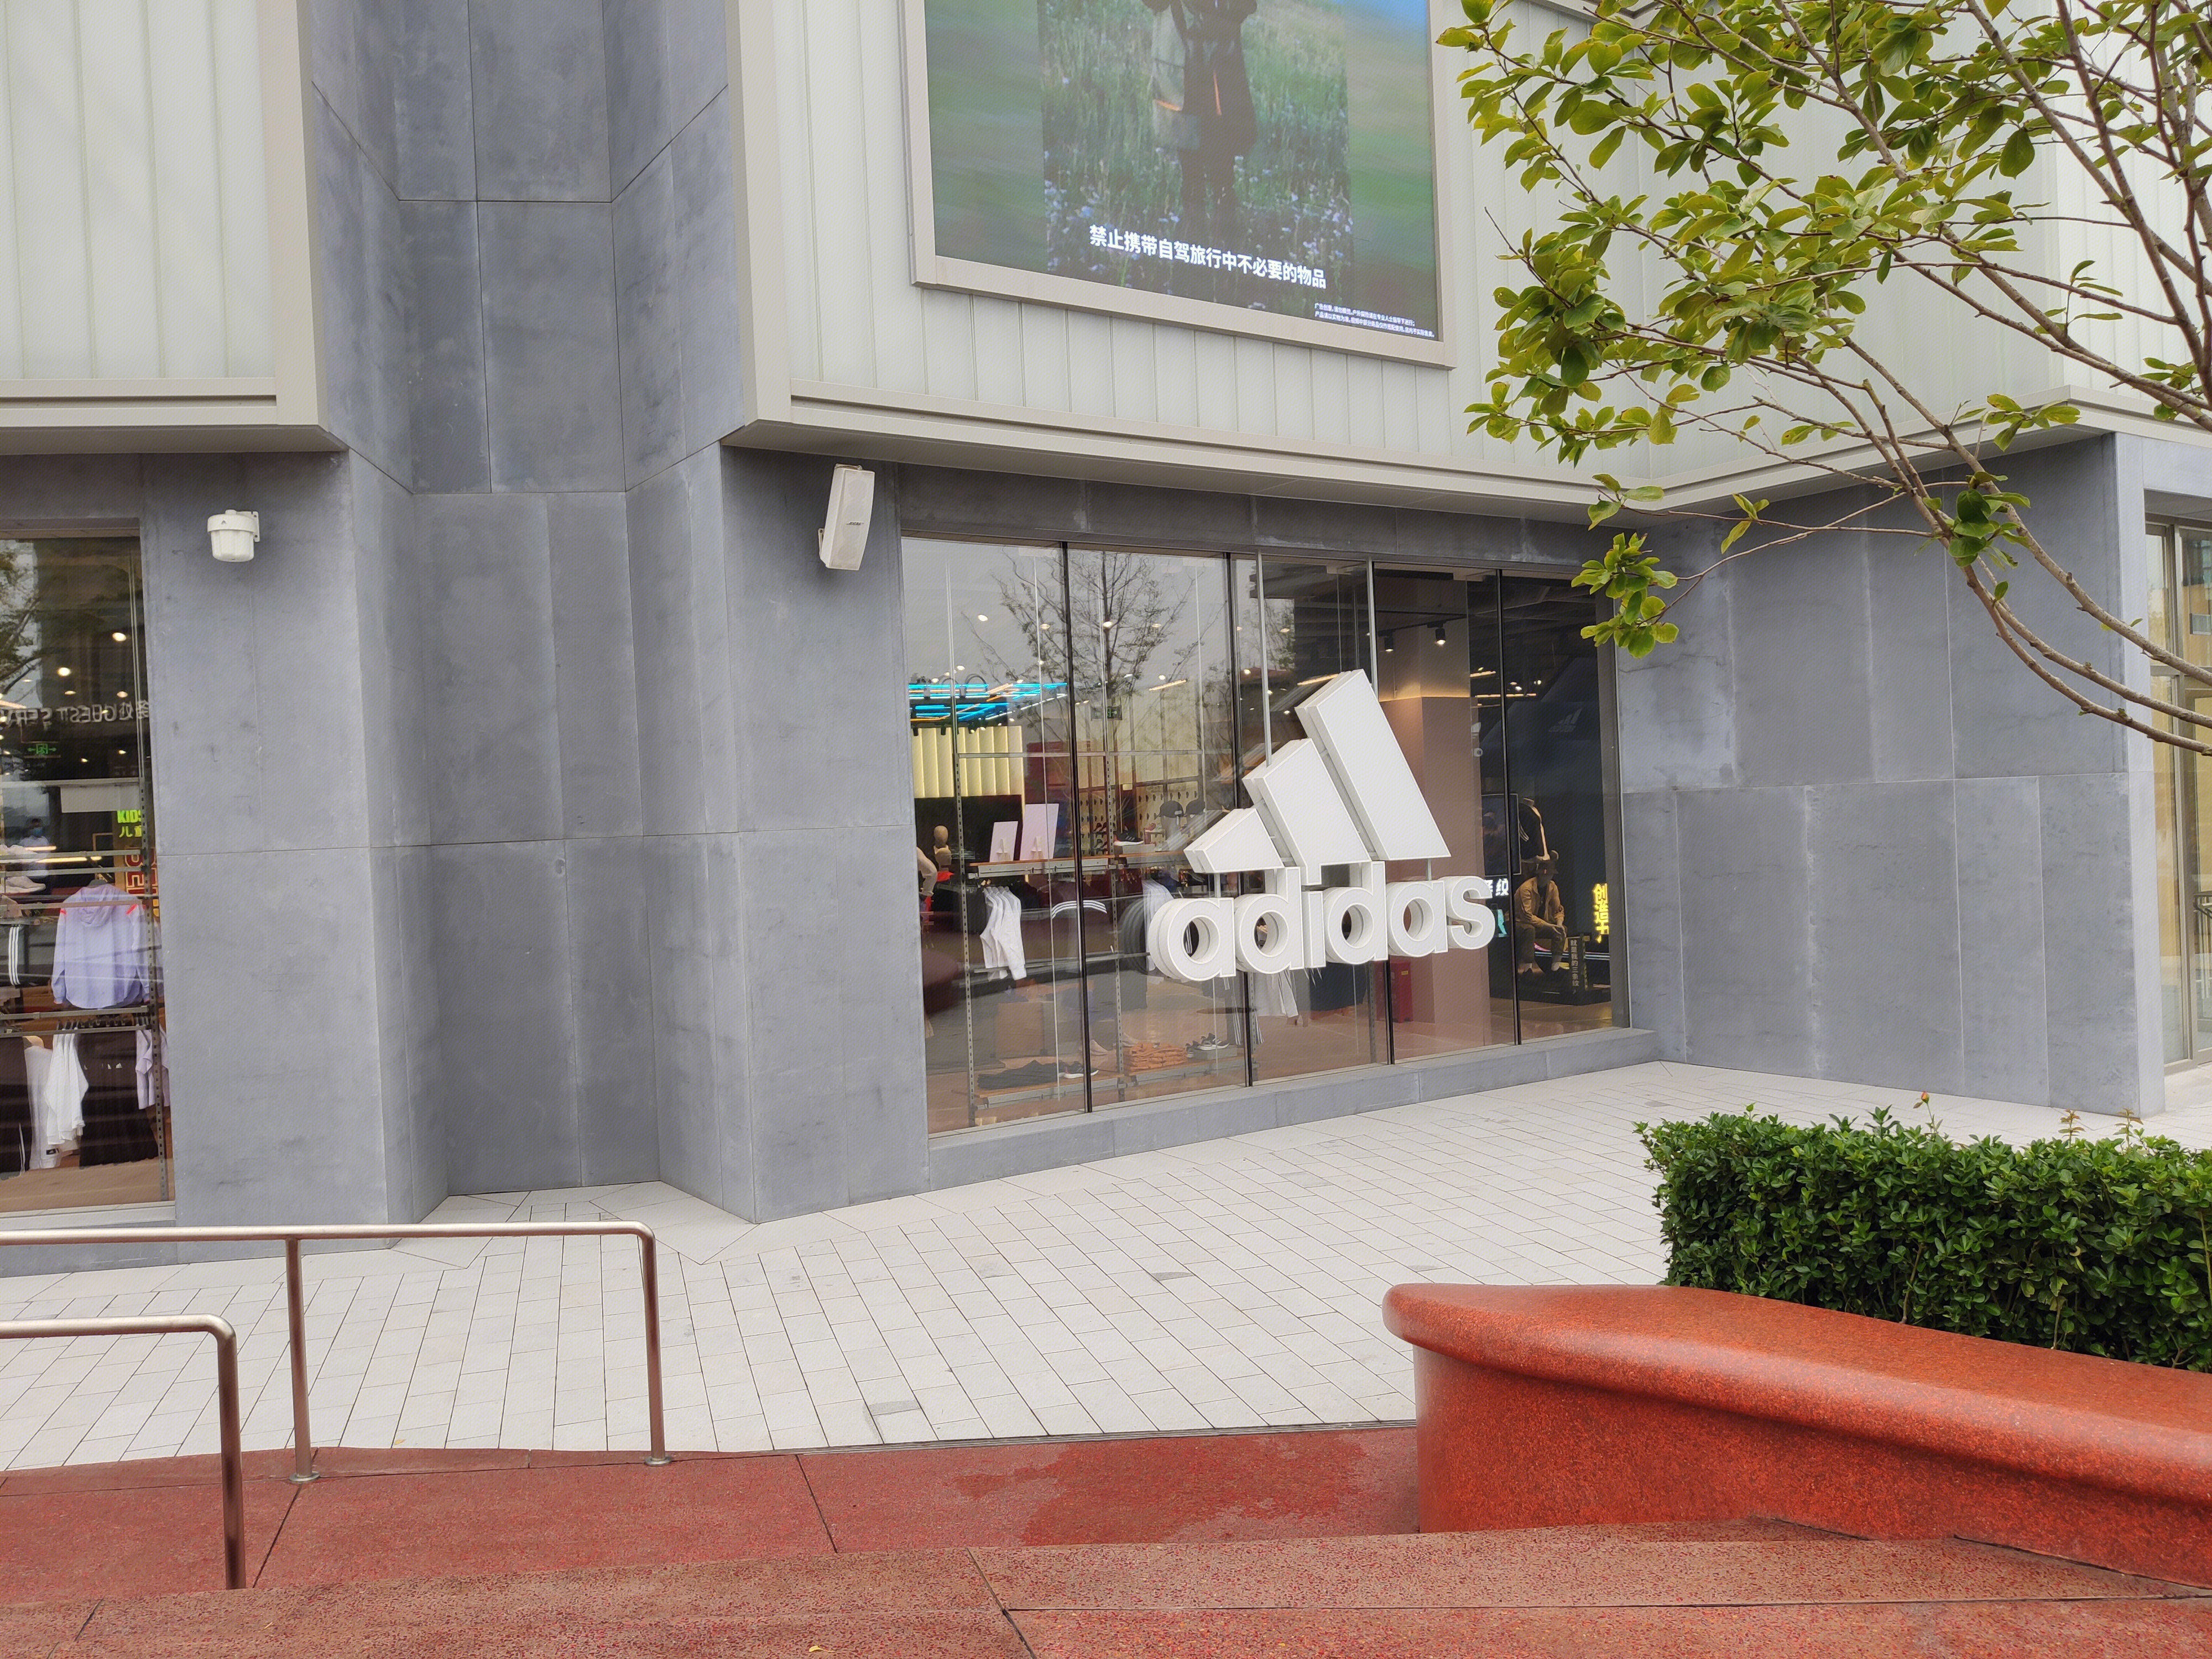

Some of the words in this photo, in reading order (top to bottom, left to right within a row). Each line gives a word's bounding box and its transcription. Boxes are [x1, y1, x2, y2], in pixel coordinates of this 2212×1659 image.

[1089, 225, 1327, 289] 禁止携带自驾旅行中不必要的物品
[1149, 861, 1496, 981] adidas
